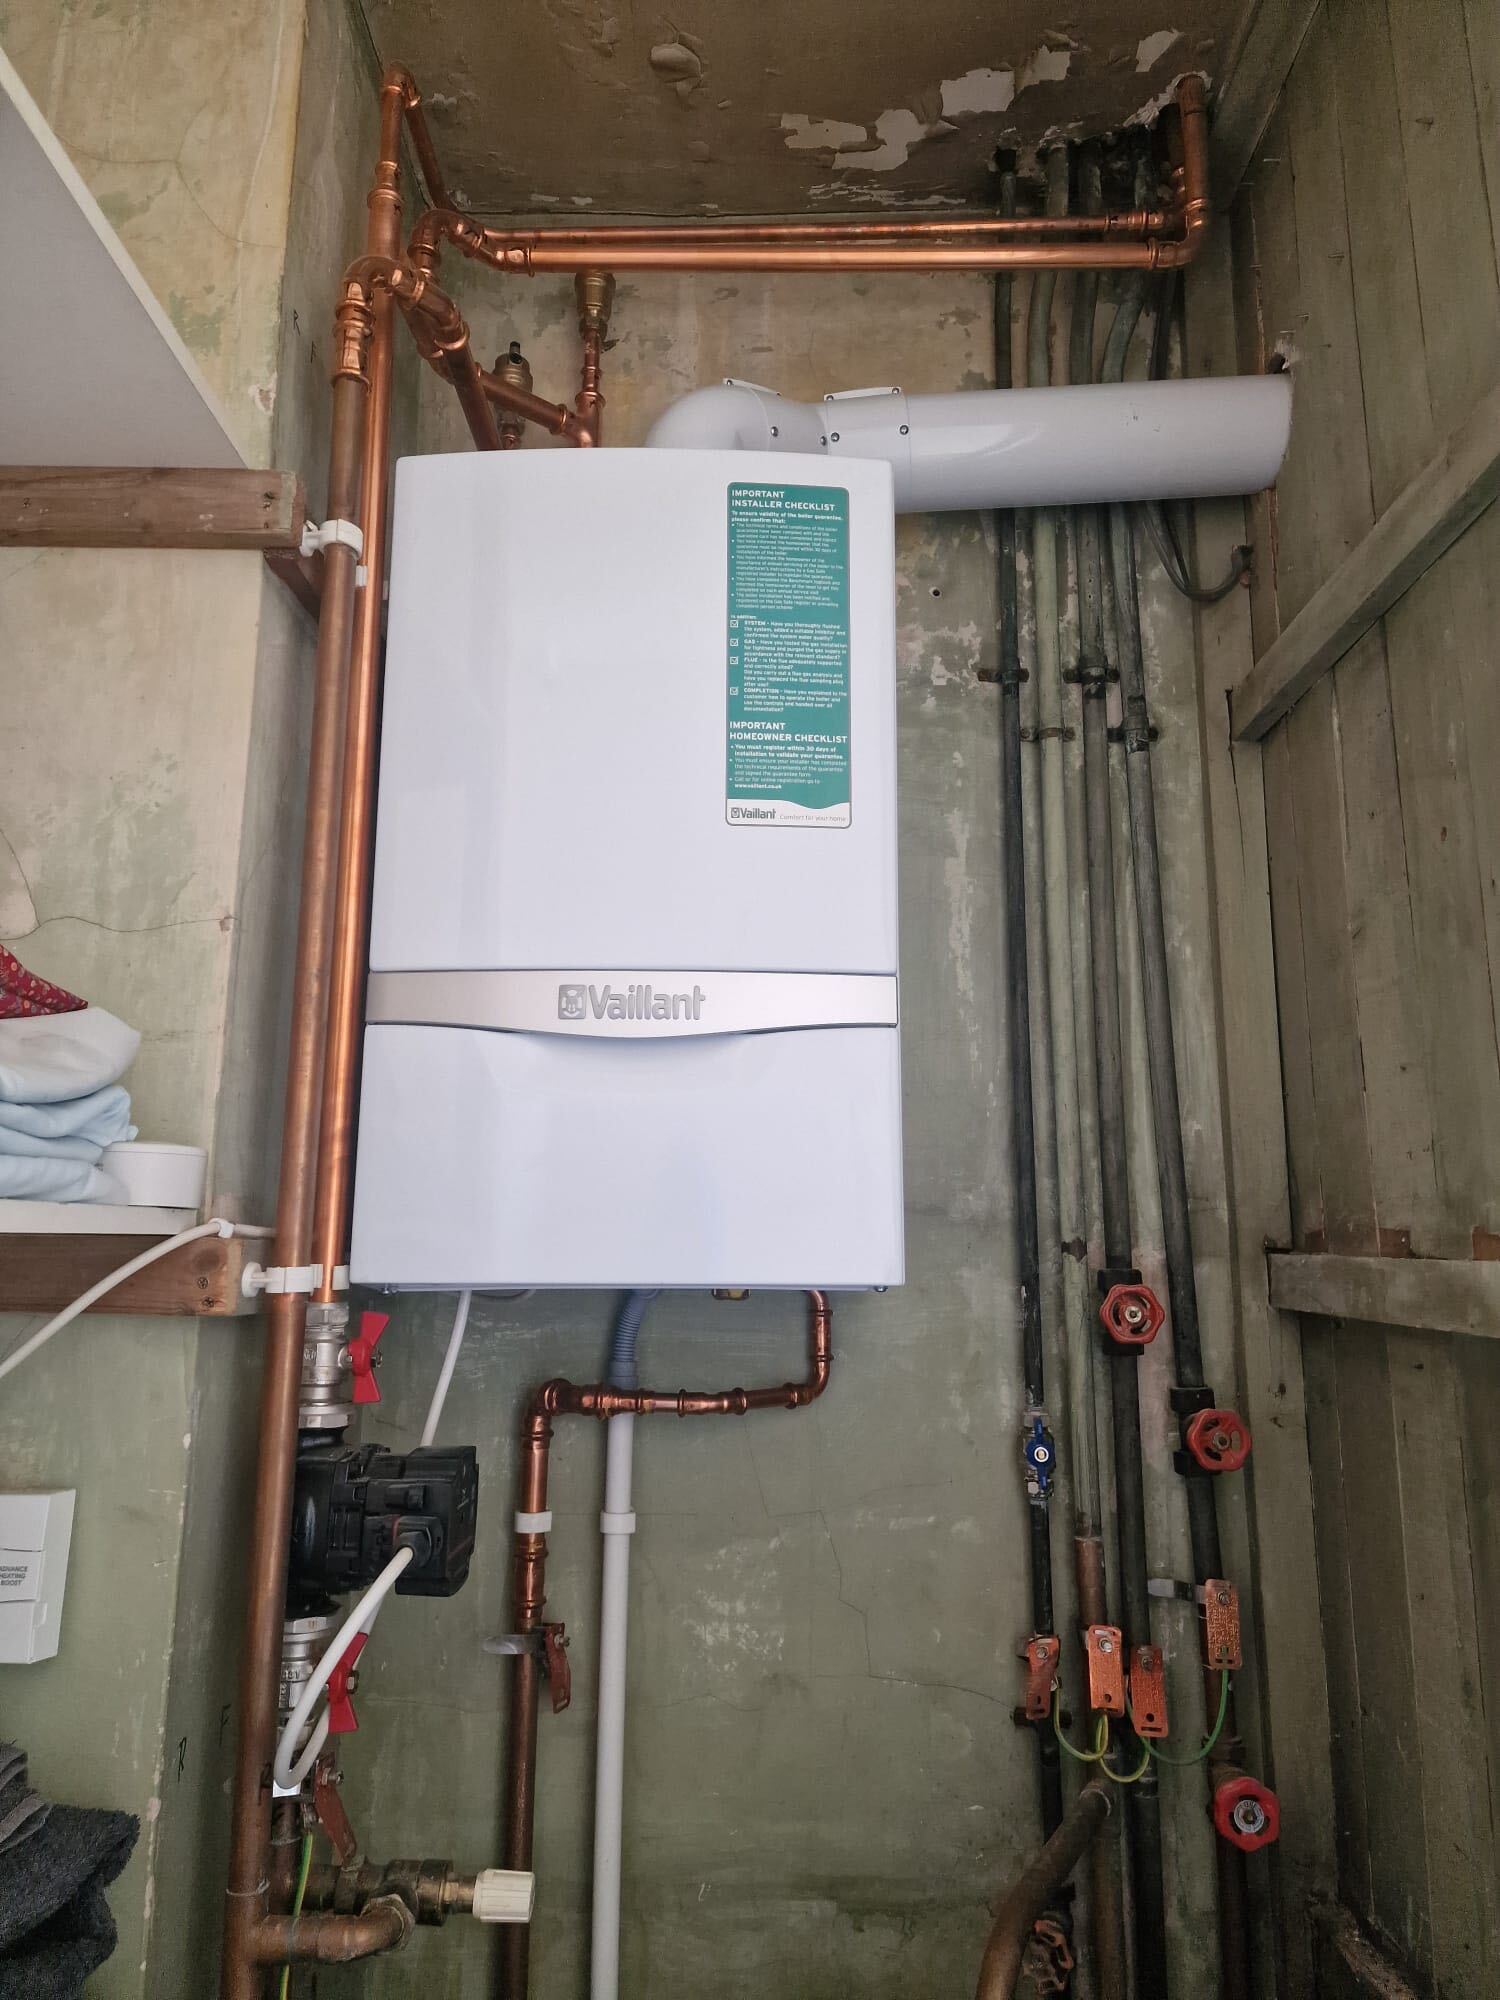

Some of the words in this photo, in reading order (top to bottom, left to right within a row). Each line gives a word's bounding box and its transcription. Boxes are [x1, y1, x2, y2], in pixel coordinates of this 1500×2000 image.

[731, 490, 784, 498] IMPORTANT
[731, 499, 782, 508] INSTALLER
[784, 502, 835, 510] CHECKLIST
[729, 721, 786, 730] IMPORTANT
[729, 732, 792, 741] HOMEOWNER
[794, 734, 848, 742] CHECKLIST
[740, 808, 776, 819] Vaillant
[588, 984, 706, 1020] Vaillant
